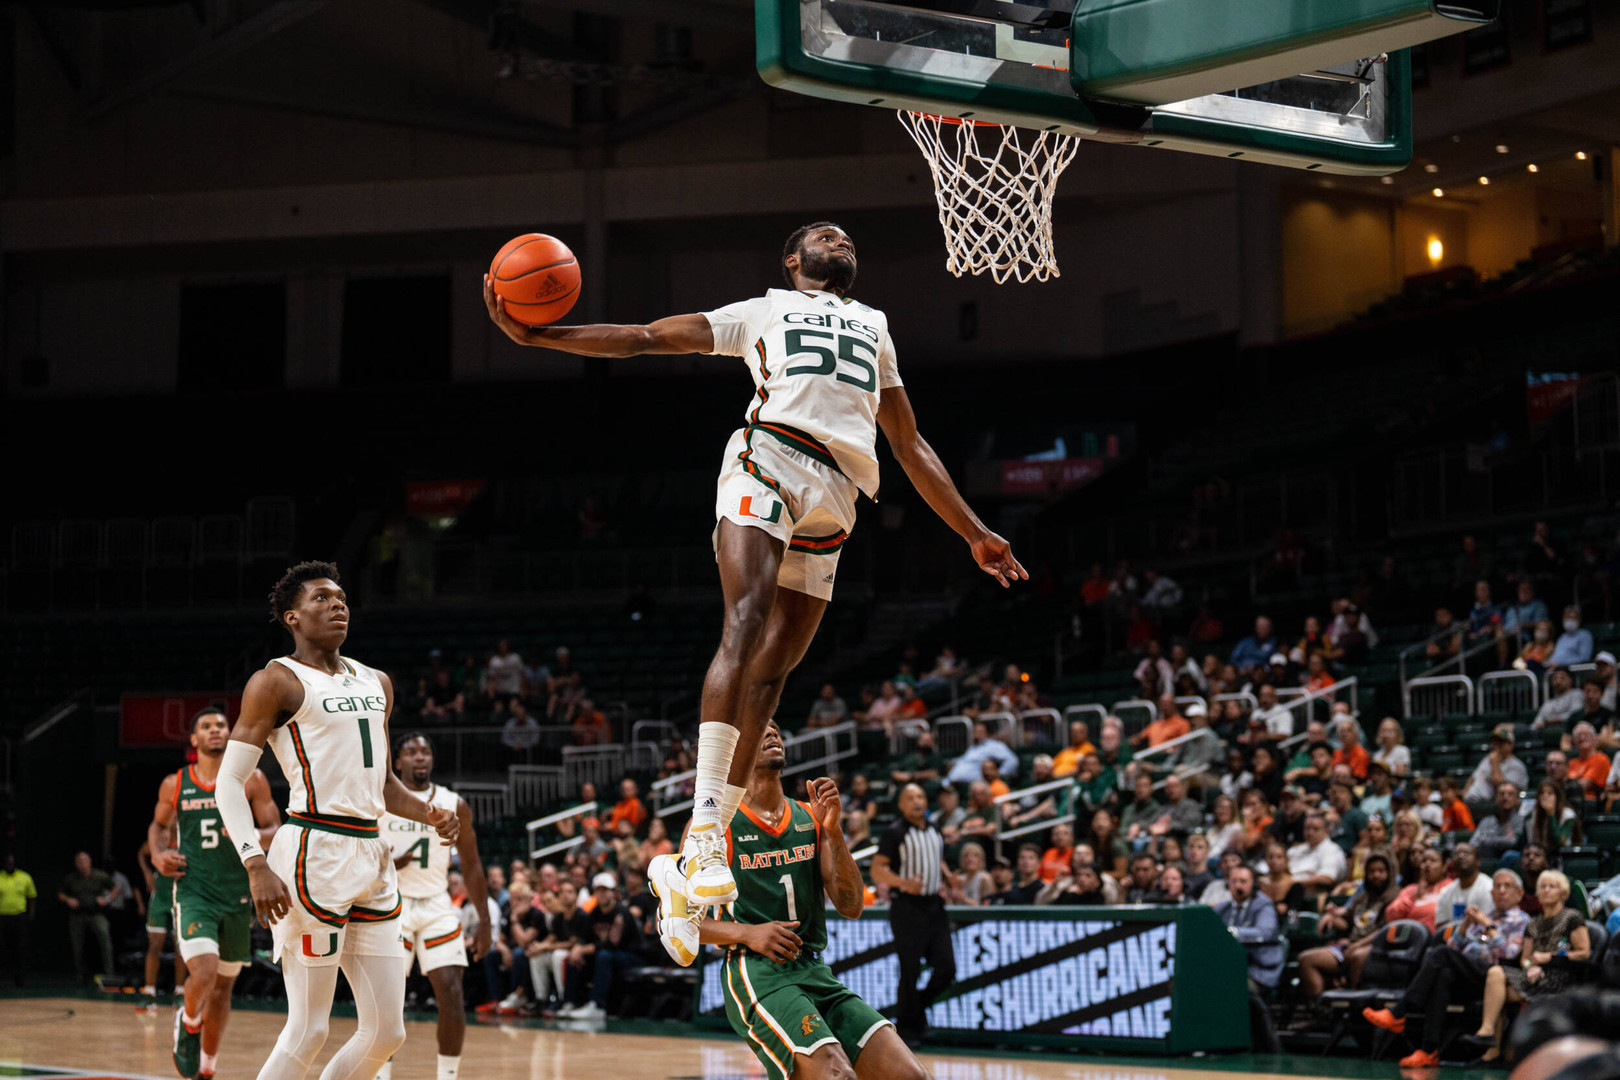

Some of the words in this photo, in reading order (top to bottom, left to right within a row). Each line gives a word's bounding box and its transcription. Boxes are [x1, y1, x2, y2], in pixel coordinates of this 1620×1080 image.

[785, 329, 877, 393] 55
[739, 496, 783, 524] U
[357, 718, 374, 768] 1
[181, 797, 217, 811] RATTL
[200, 818, 219, 849] 5
[402, 838, 429, 869] 4
[739, 843, 815, 870] RATTLERS
[778, 873, 797, 920] 1
[302, 932, 338, 957] U
